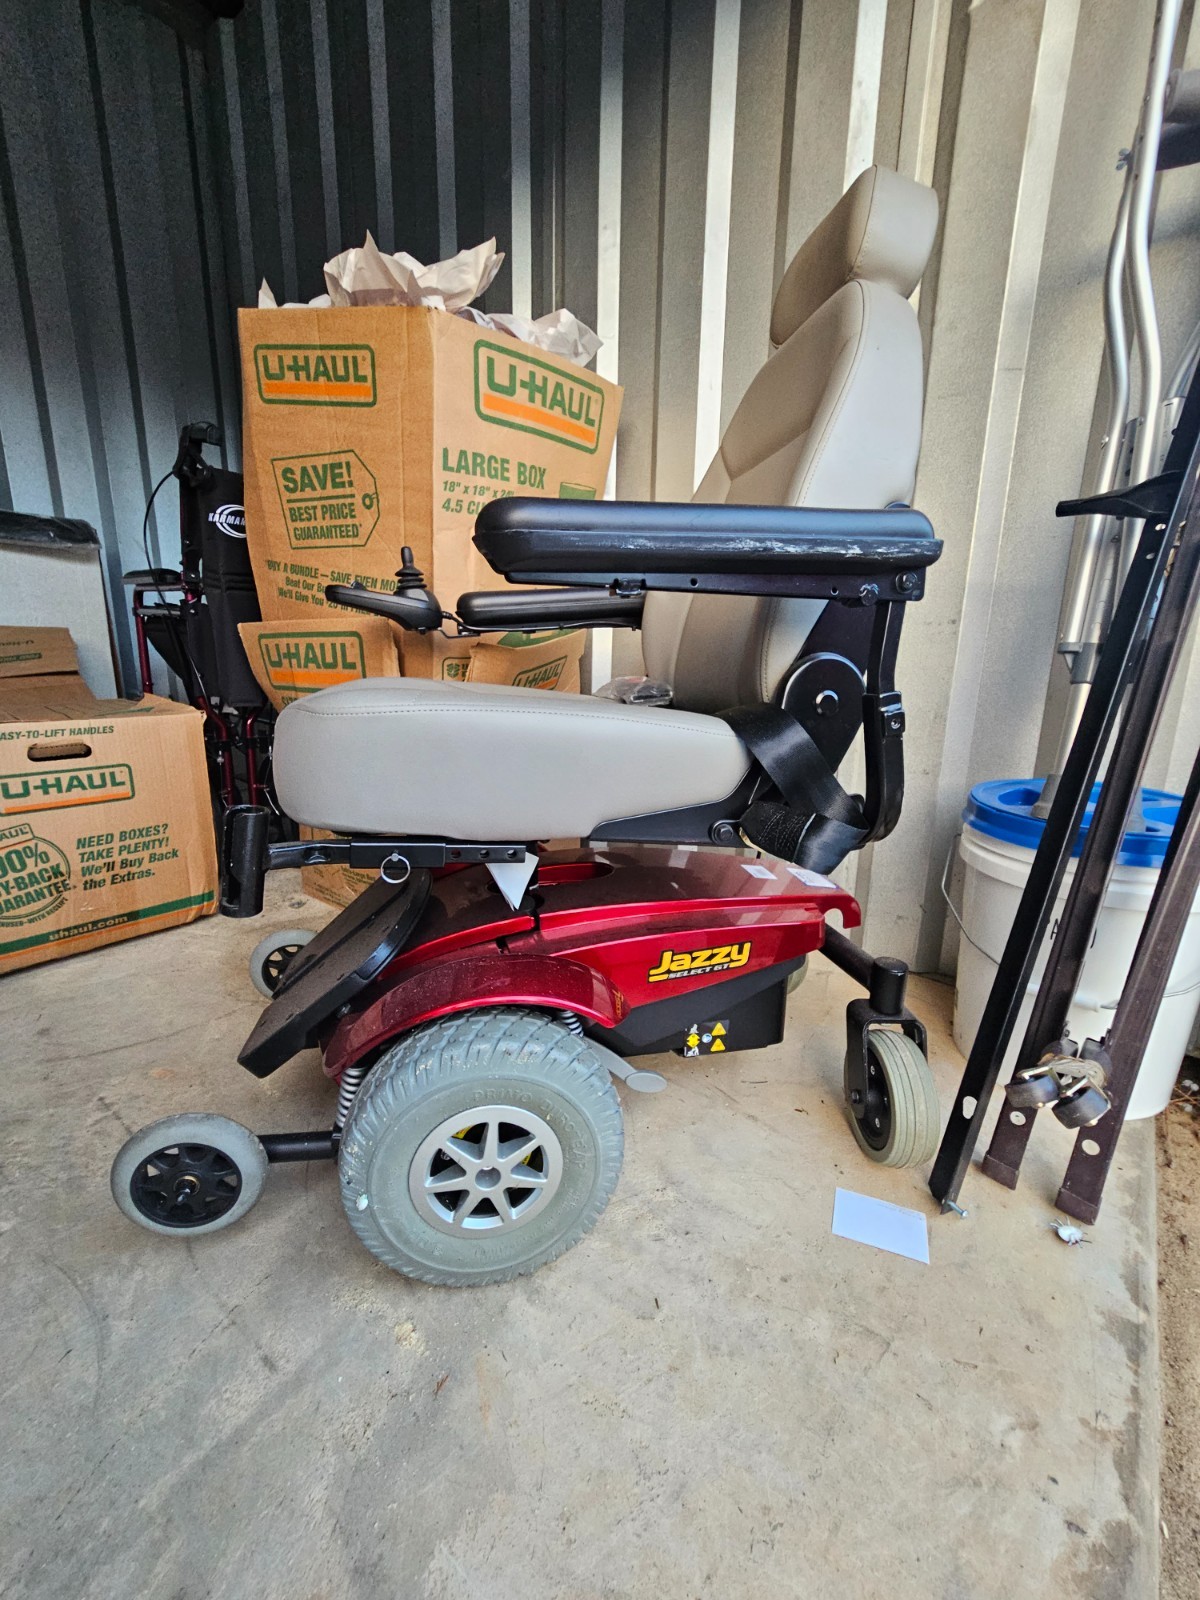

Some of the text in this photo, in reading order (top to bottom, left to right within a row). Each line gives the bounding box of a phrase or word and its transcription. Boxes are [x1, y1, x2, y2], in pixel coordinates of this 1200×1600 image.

[262, 355, 368, 383] U-HAUL
[486, 356, 596, 428] U-HAUL
[281, 461, 354, 493] SAVE!
[442, 447, 547, 490] LARGE BOX
[443, 480, 461, 493] 18"
[473, 484, 491, 497] 18"
[288, 502, 357, 523] BEST PRICE
[442, 497, 463, 513] 4.5
[286, 576, 300, 588] Beat
[302, 580, 315, 591] Our
[290, 564, 319, 578] BUNDLE
[330, 570, 352, 584] SAVE
[278, 587, 293, 599] We'll
[295, 591, 309, 603] Give
[311, 594, 324, 606] You
[265, 642, 357, 670] U-HAUL
[0, 725, 114, 740] ASY-TO-LIFT HANDLES
[1, 771, 125, 799] U-HAUL
[76, 823, 169, 849] NEED BOXES?
[79, 837, 169, 863] TAKE PLENTY!
[81, 848, 179, 877] We'll Buy Back
[83, 868, 155, 891] the Extras.
[49, 916, 128, 941] uhaul.com
[649, 942, 751, 979] Jazzy
[668, 966, 713, 979] SELECT
